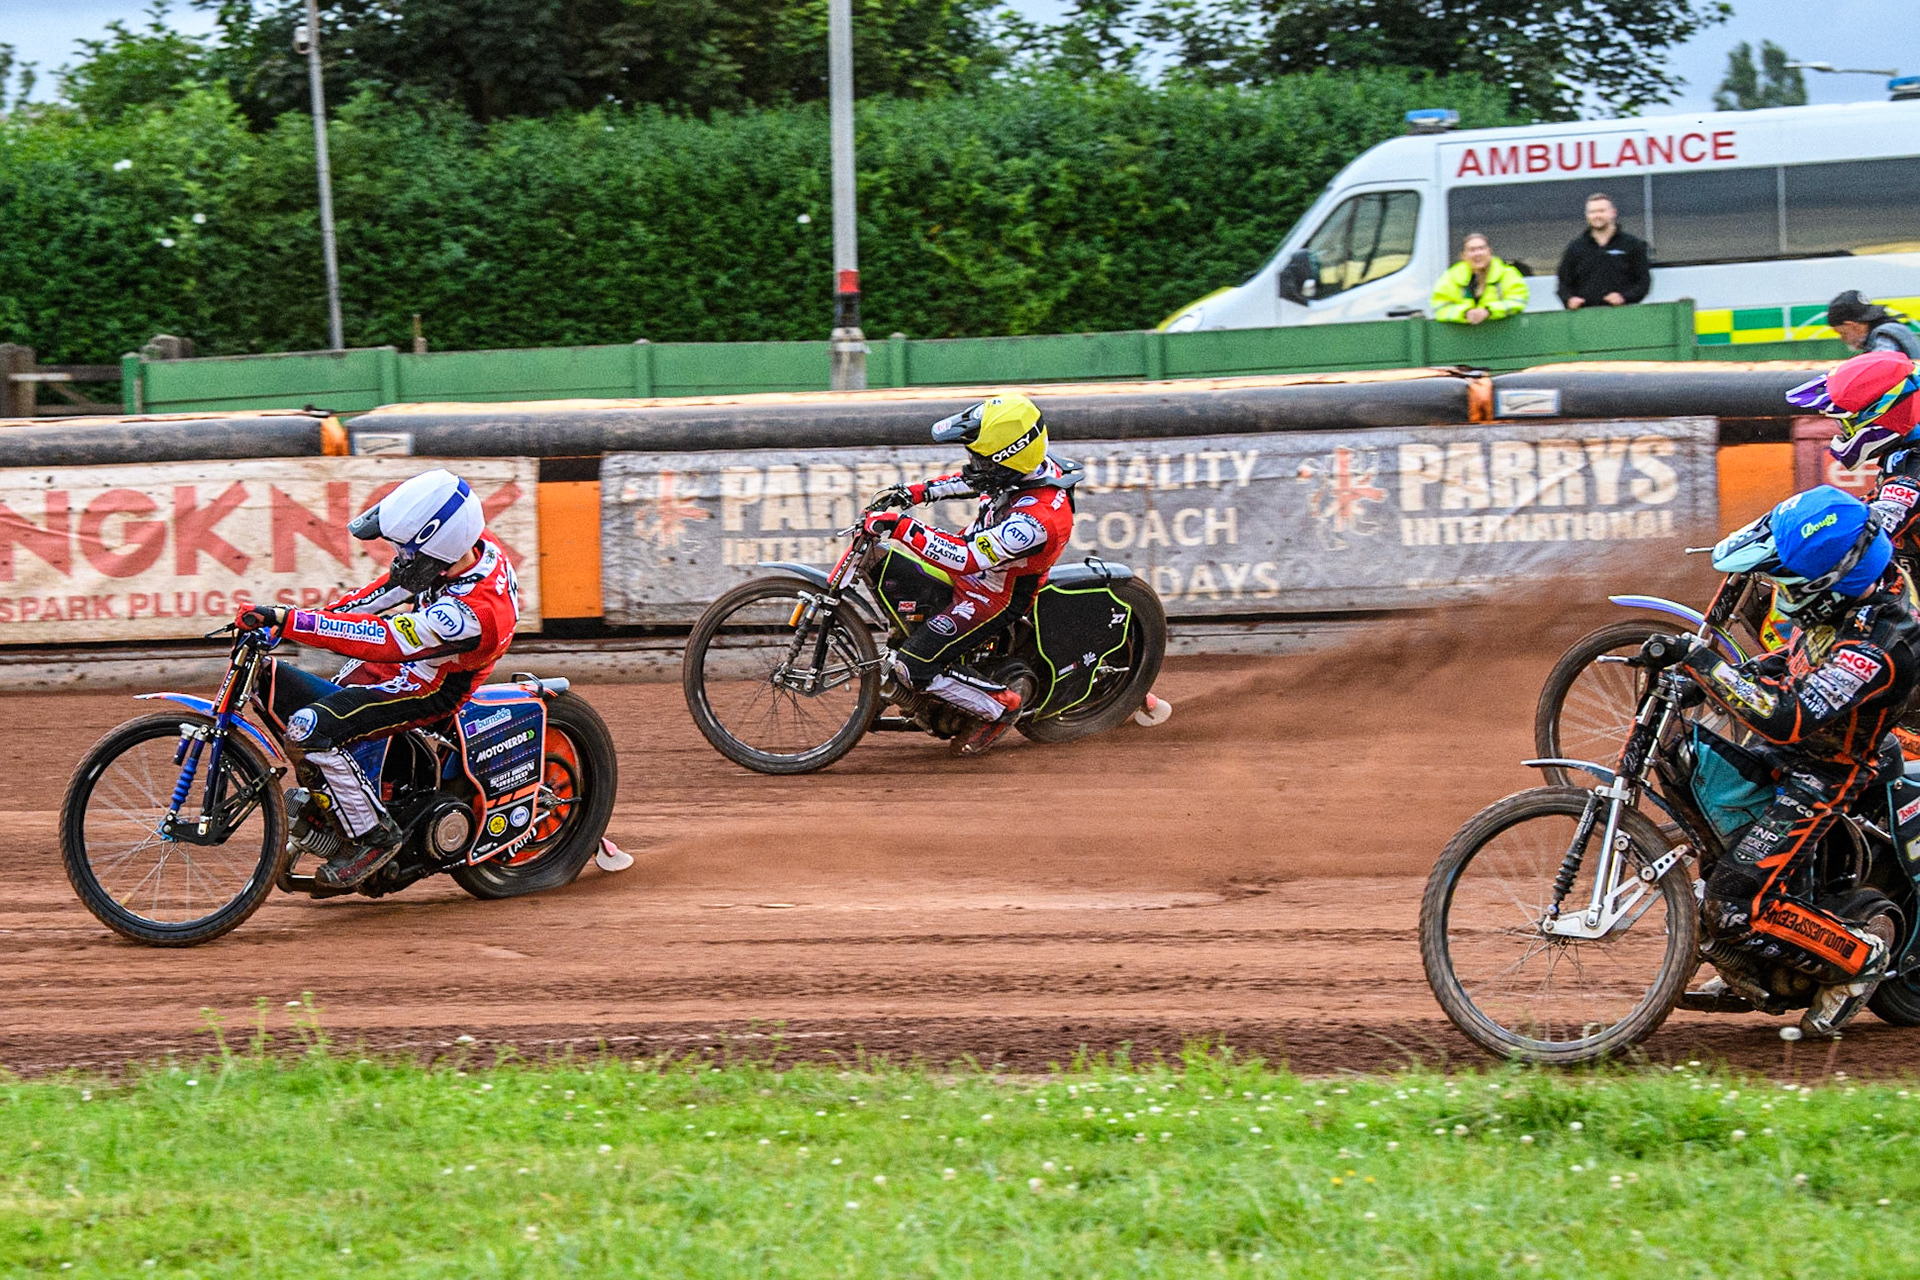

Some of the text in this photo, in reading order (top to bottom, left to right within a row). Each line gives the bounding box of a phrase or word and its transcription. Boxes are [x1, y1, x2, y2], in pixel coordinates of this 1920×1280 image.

[1456, 130, 1737, 178] AMBULANCE
[991, 433, 1032, 463] OAKLEY
[1078, 450, 1259, 493] UALITY
[1399, 434, 1680, 512] PARRYS
[1883, 485, 1917, 502] NGK
[0, 481, 253, 582] NGK
[1007, 526, 1030, 545] ATPI
[1070, 507, 1239, 550] COACH
[1400, 509, 1678, 547] INTERNATIONAL
[924, 549, 940, 561] LTD
[928, 543, 967, 564] PLASTICS
[127, 588, 253, 619] PLUGS
[318, 615, 386, 640] burnside
[432, 608, 458, 632] ATPI
[1841, 651, 1878, 677] NGK
[475, 707, 512, 730] burnside
[475, 732, 529, 763] MOTOVERDE
